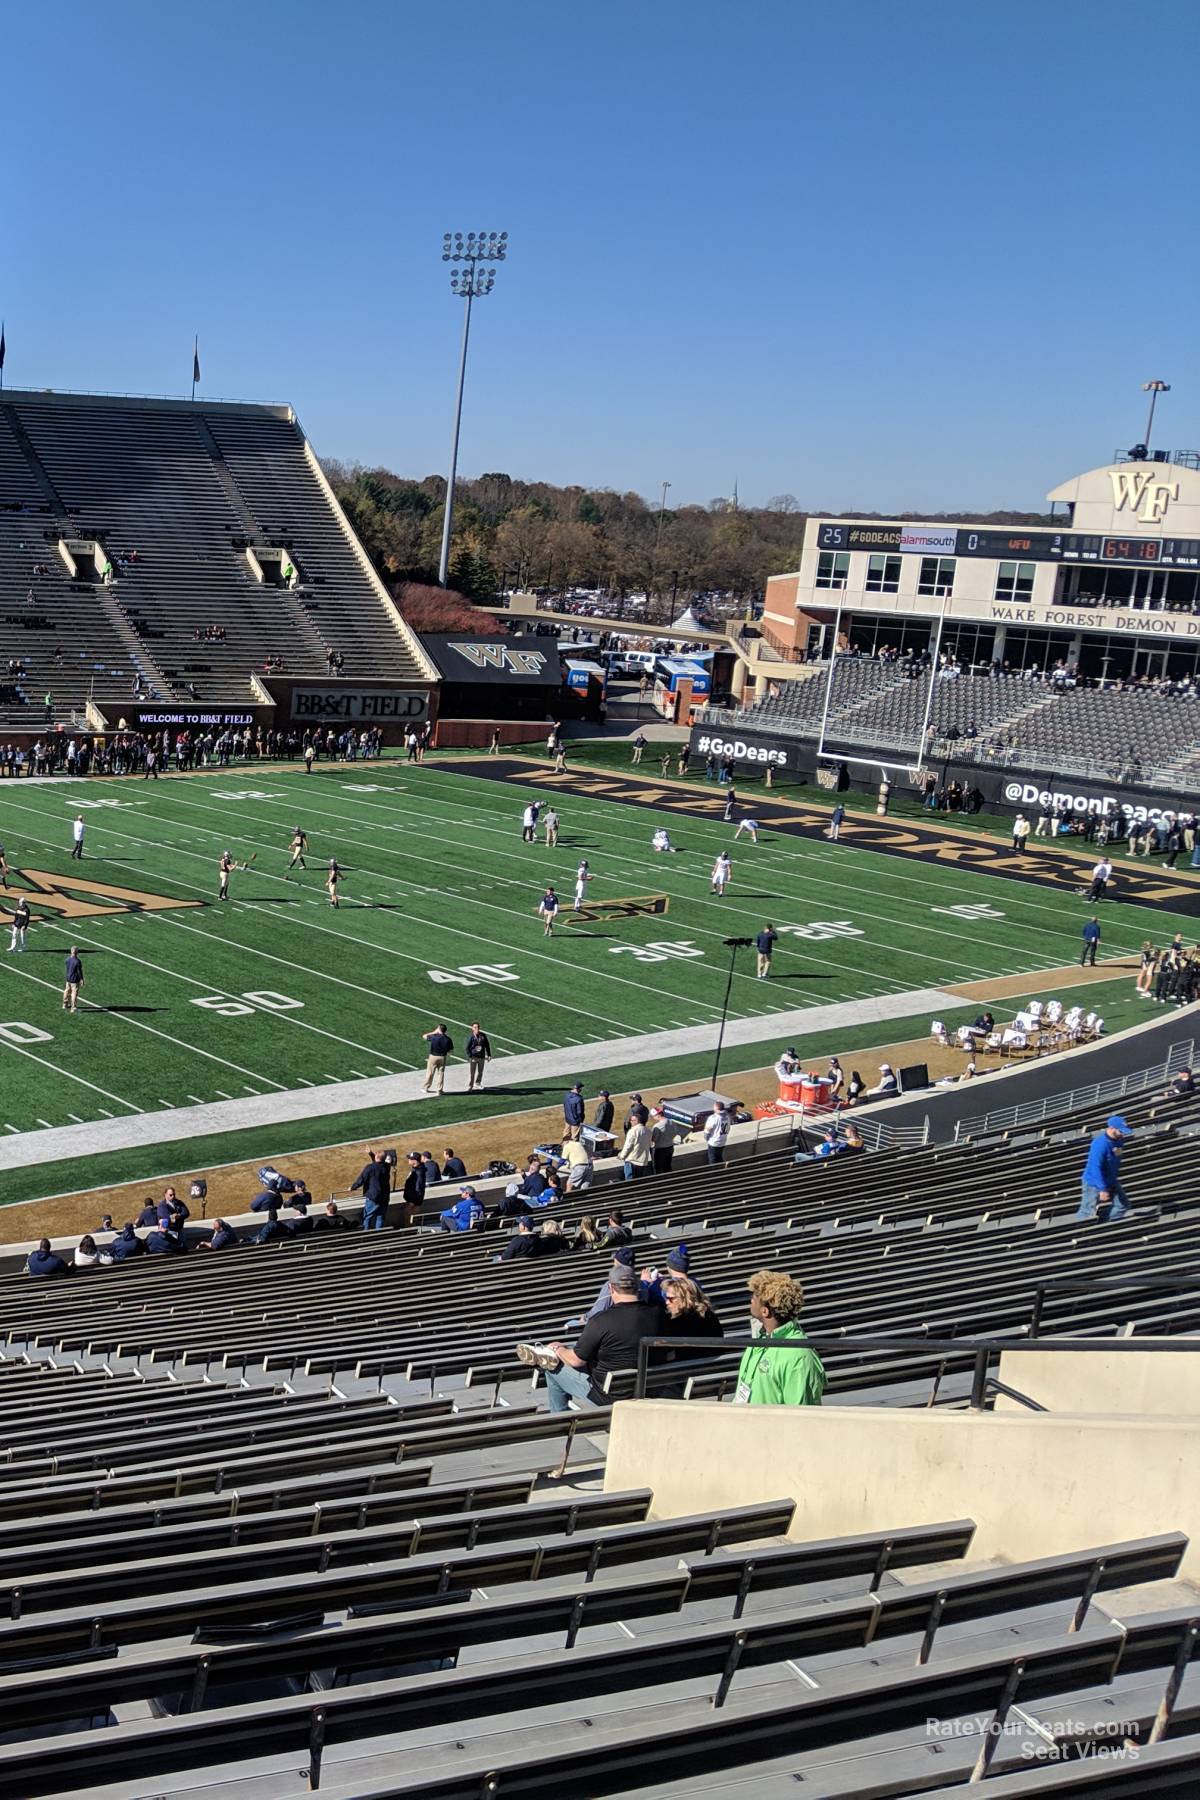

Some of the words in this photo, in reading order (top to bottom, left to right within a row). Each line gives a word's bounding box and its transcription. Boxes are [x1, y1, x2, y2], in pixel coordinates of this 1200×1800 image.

[1109, 471, 1179, 524] WF
[823, 528, 842, 544] 25
[850, 530, 900, 545] #GODEACS
[900, 534, 955, 547] alarmsouth
[991, 607, 1036, 622] WAKE
[1045, 611, 1107, 627] FOREST
[1116, 616, 1176, 633] DEMON
[447, 642, 547, 675] WF
[294, 692, 357, 717] BB&T
[358, 694, 425, 717] FIELD
[139, 714, 184, 724] WELCOME
[186, 714, 198, 724] TO
[224, 714, 253, 724] FIELD
[698, 736, 788, 766] #GoDeacs
[756, 813, 1200, 902] FOREST
[781, 919, 865, 941] 20
[609, 940, 705, 963] 30
[427, 963, 520, 986] 40
[190, 990, 305, 1017] 50
